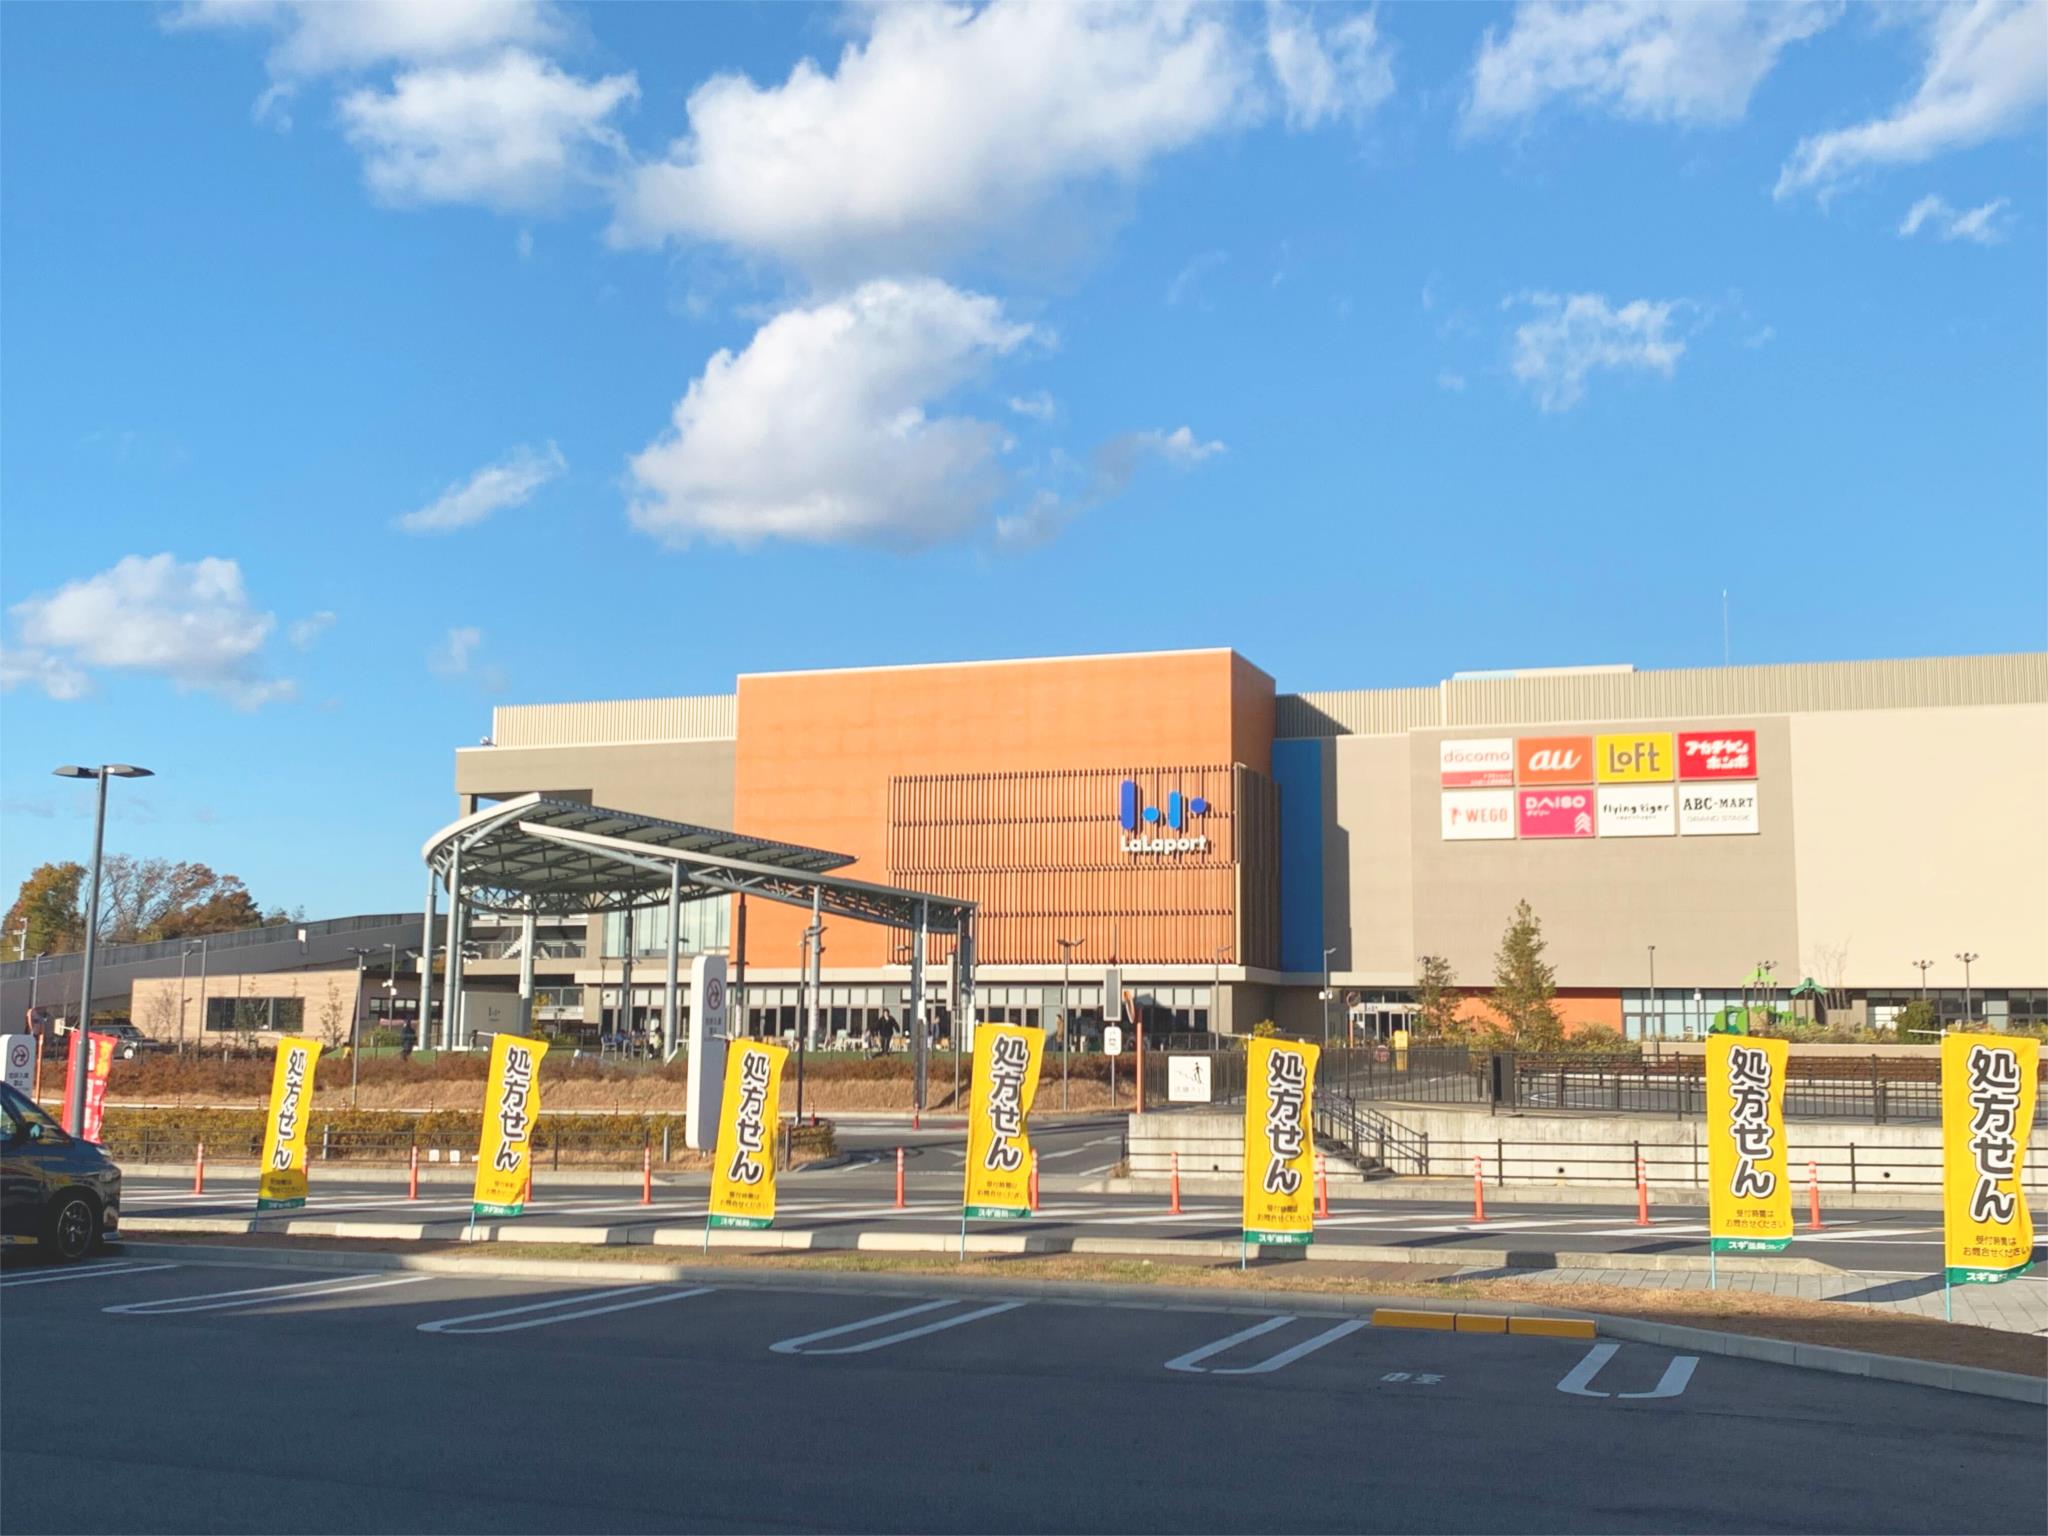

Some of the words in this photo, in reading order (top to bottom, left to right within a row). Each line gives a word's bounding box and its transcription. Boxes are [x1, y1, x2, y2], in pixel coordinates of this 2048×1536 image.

[1444, 750, 1510, 763] docomo
[1528, 749, 1582, 771] au
[1525, 796, 1586, 809] DAISO
[1603, 803, 1637, 815] flying
[1640, 803, 1670, 814] tiger
[1683, 797, 1753, 811] ABC-MART
[1466, 808, 1508, 823] WEGO
[1121, 834, 1207, 855] LaLaport
[495, 1046, 532, 1170] 処方せん
[987, 1035, 1027, 1169] 処方せん
[730, 1051, 768, 1182] 処方せん
[1265, 1050, 1304, 1193] 処方せん
[1731, 1047, 1773, 1196] 処方せん
[1971, 1047, 2018, 1220] 処方せん
